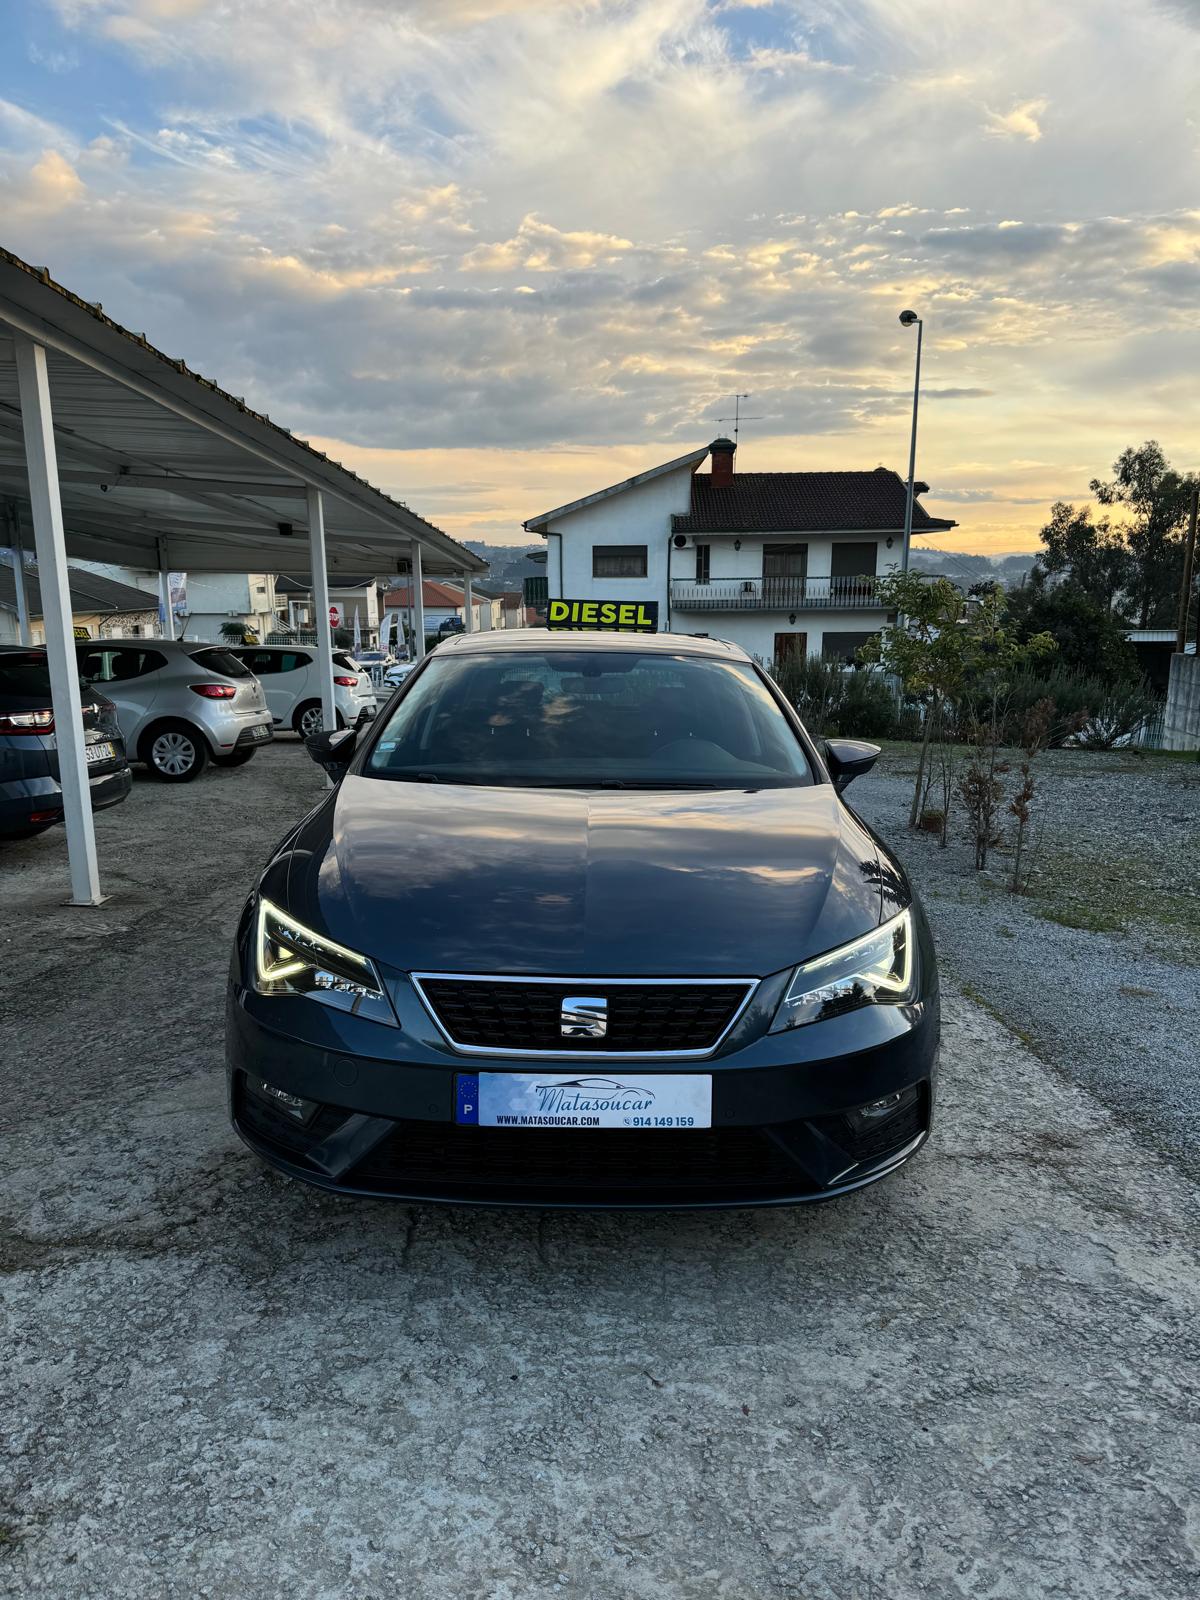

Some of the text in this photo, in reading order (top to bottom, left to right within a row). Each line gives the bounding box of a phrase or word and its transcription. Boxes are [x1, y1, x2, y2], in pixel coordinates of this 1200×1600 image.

[549, 601, 652, 625] DIESEL
[537, 1088, 652, 1114] Matasoucar
[463, 1104, 473, 1115] P
[496, 1114, 600, 1126] WWW.MATASOUCAR.COM
[633, 1116, 695, 1127] 914 149 159
